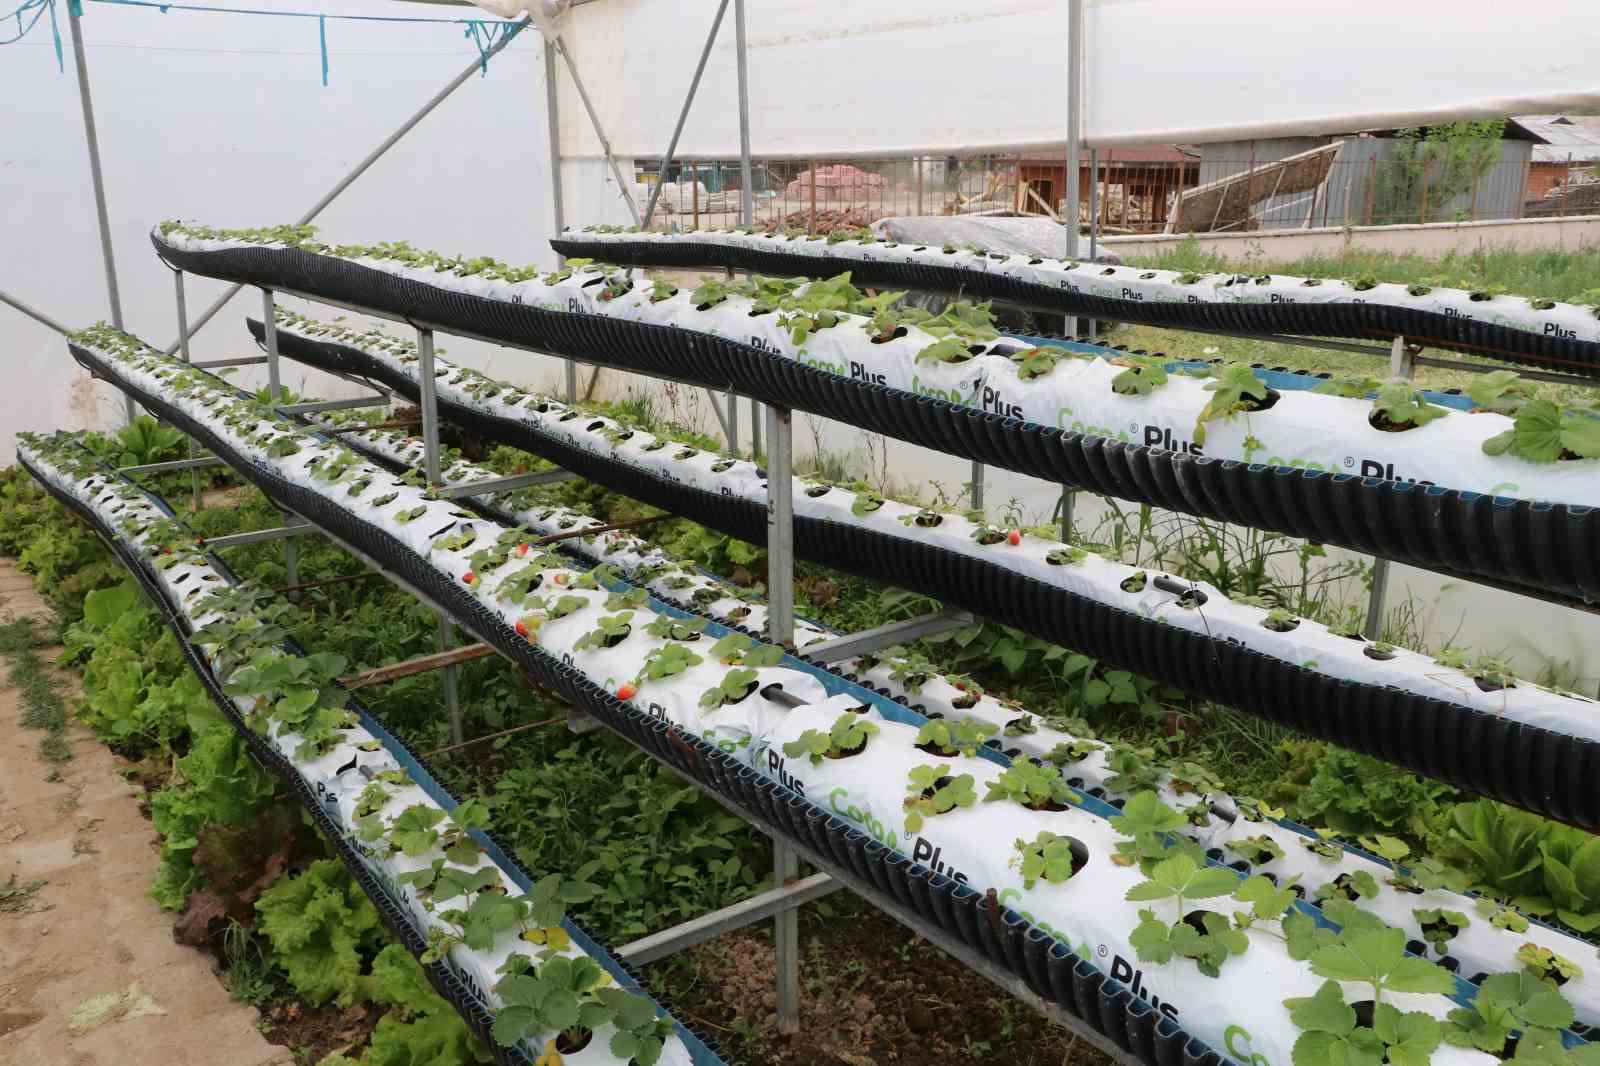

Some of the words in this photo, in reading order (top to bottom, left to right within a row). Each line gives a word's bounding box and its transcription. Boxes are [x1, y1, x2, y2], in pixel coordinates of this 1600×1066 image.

[1122, 287, 1144, 301] Plus
[1543, 322, 1577, 339] Plus
[850, 360, 886, 385] Plus
[983, 385, 1024, 421] Plus
[1360, 459, 1436, 487] Pl
[768, 748, 805, 798] Plus
